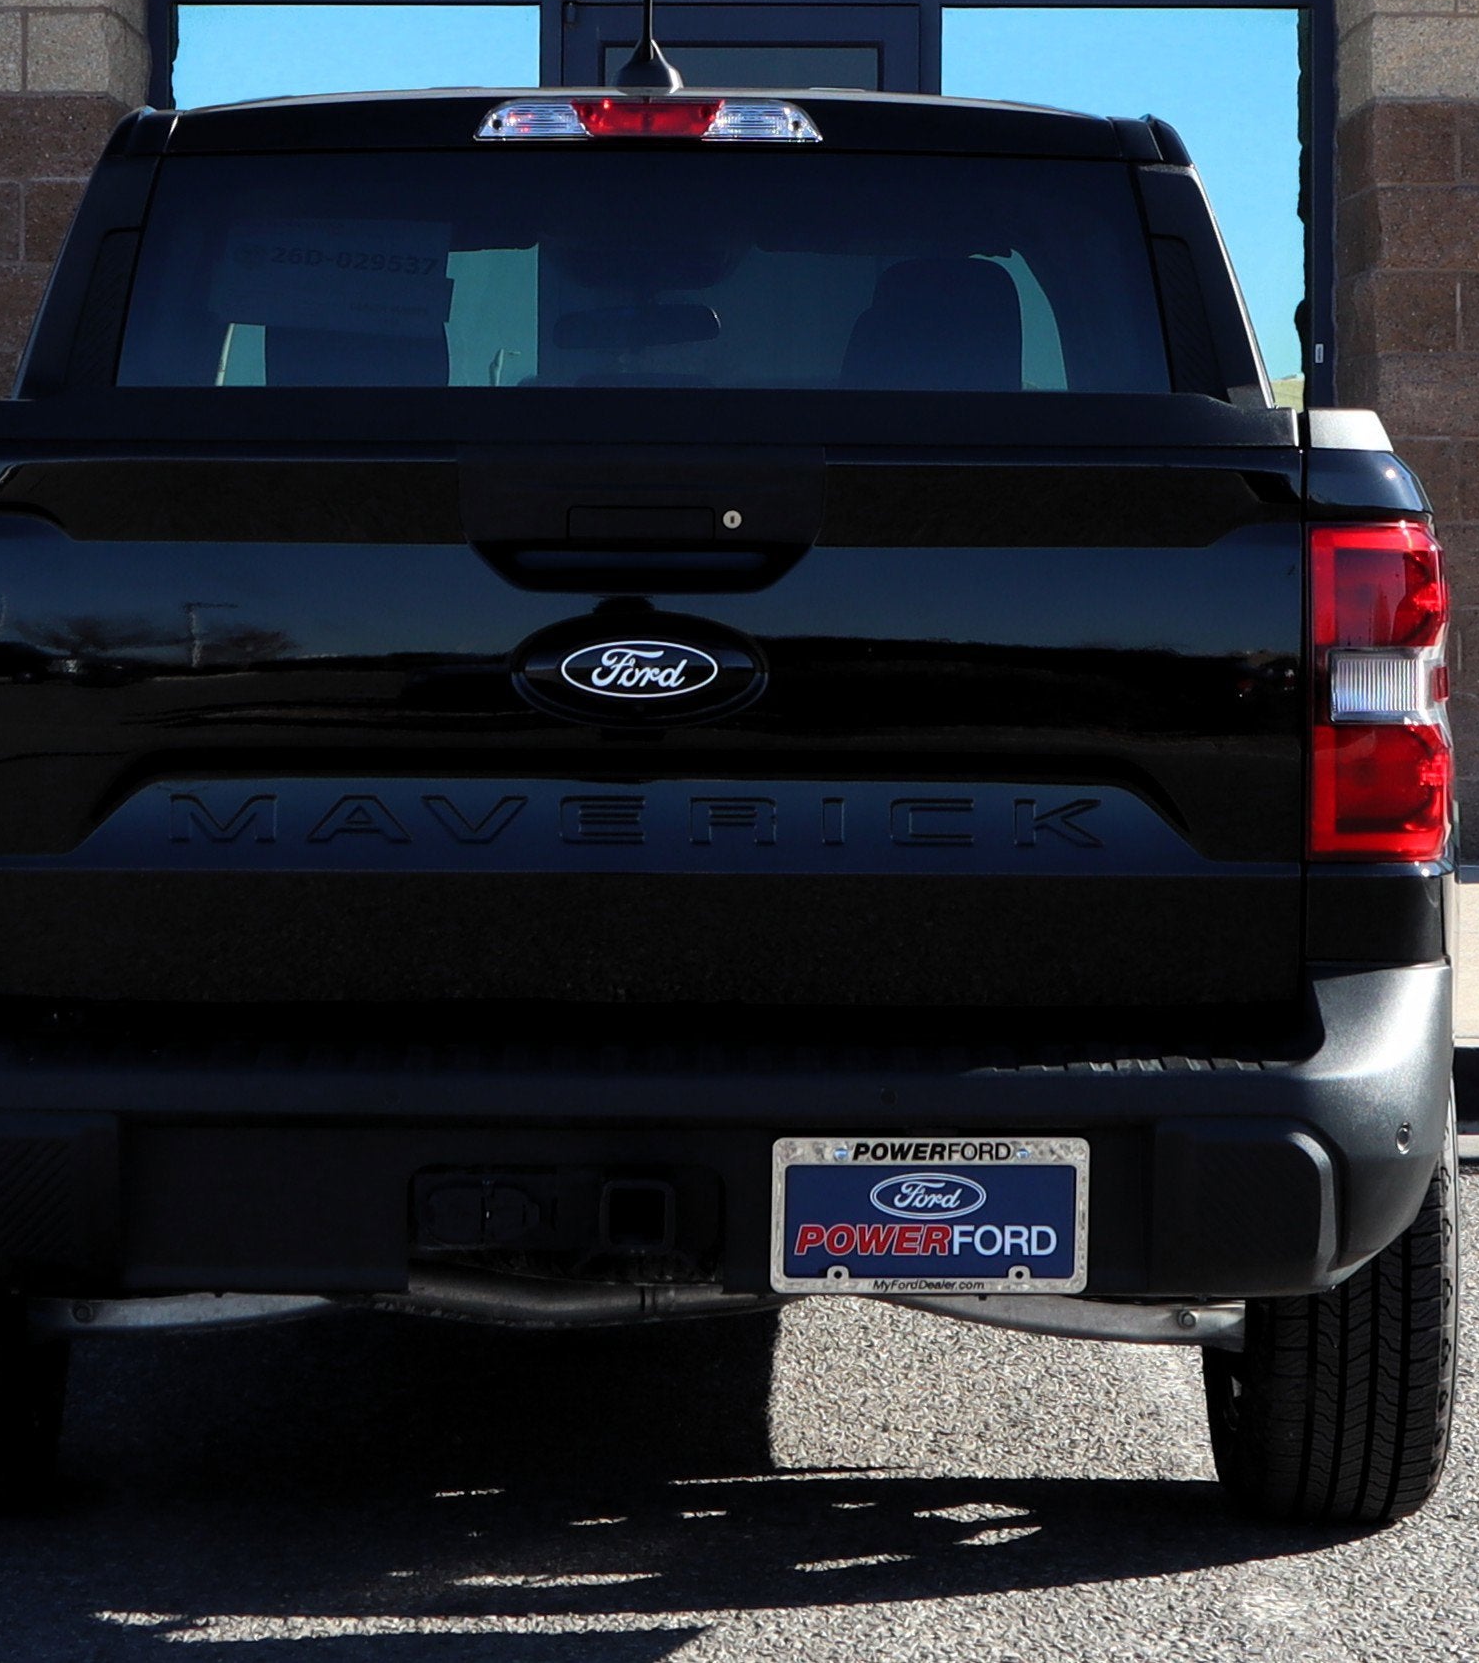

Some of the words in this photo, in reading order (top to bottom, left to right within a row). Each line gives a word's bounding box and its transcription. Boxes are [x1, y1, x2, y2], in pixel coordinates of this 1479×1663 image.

[591, 648, 688, 688] Ford
[169, 793, 1107, 849] MAVERICK
[893, 1181, 962, 1209] Ford
[873, 1280, 985, 1292] MyFordDealer.com
